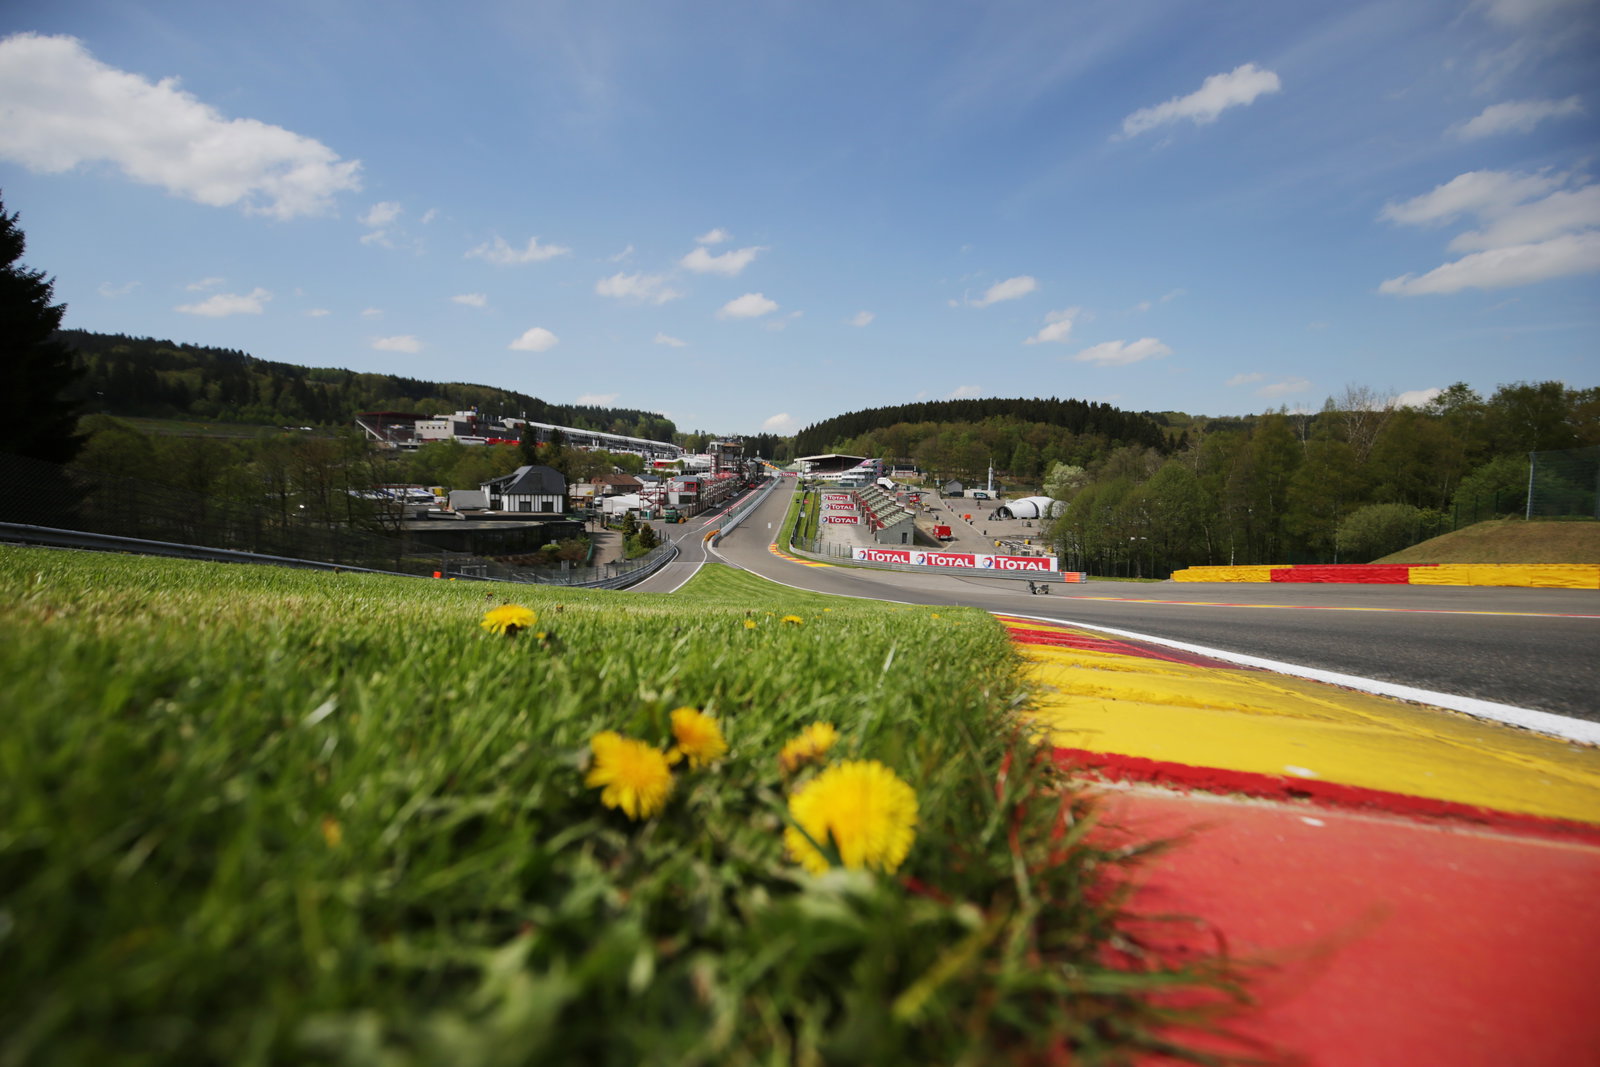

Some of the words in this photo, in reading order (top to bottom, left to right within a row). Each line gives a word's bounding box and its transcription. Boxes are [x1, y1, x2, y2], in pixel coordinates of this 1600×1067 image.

[869, 551, 908, 563] TOTAL
[929, 554, 973, 567] TOTAL
[997, 558, 1048, 571] TOTAL
